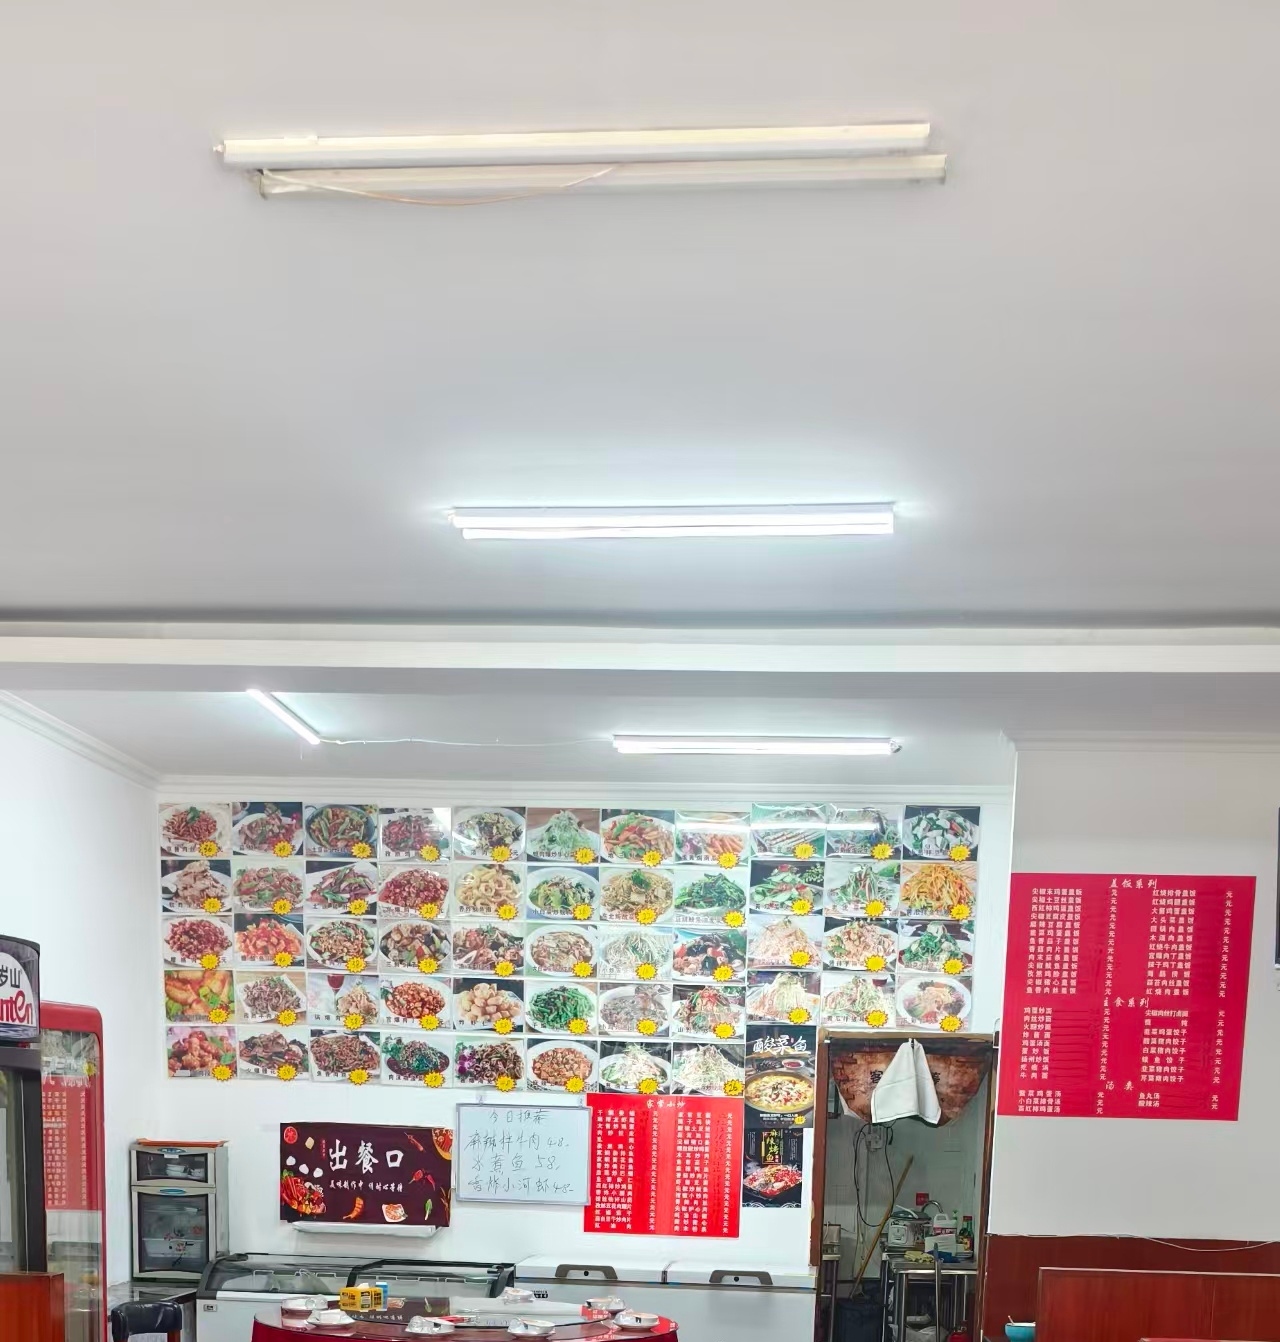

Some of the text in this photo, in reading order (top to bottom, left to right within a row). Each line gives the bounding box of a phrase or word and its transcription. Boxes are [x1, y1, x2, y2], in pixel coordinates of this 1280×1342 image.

[1109, 878, 1157, 889] 盖饭系列
[753, 1035, 808, 1055] 酸菜鱼
[490, 1108, 550, 1124] 今日推荐
[329, 1139, 404, 1174] 出餐口
[472, 1153, 524, 1175] 水煮鱼
